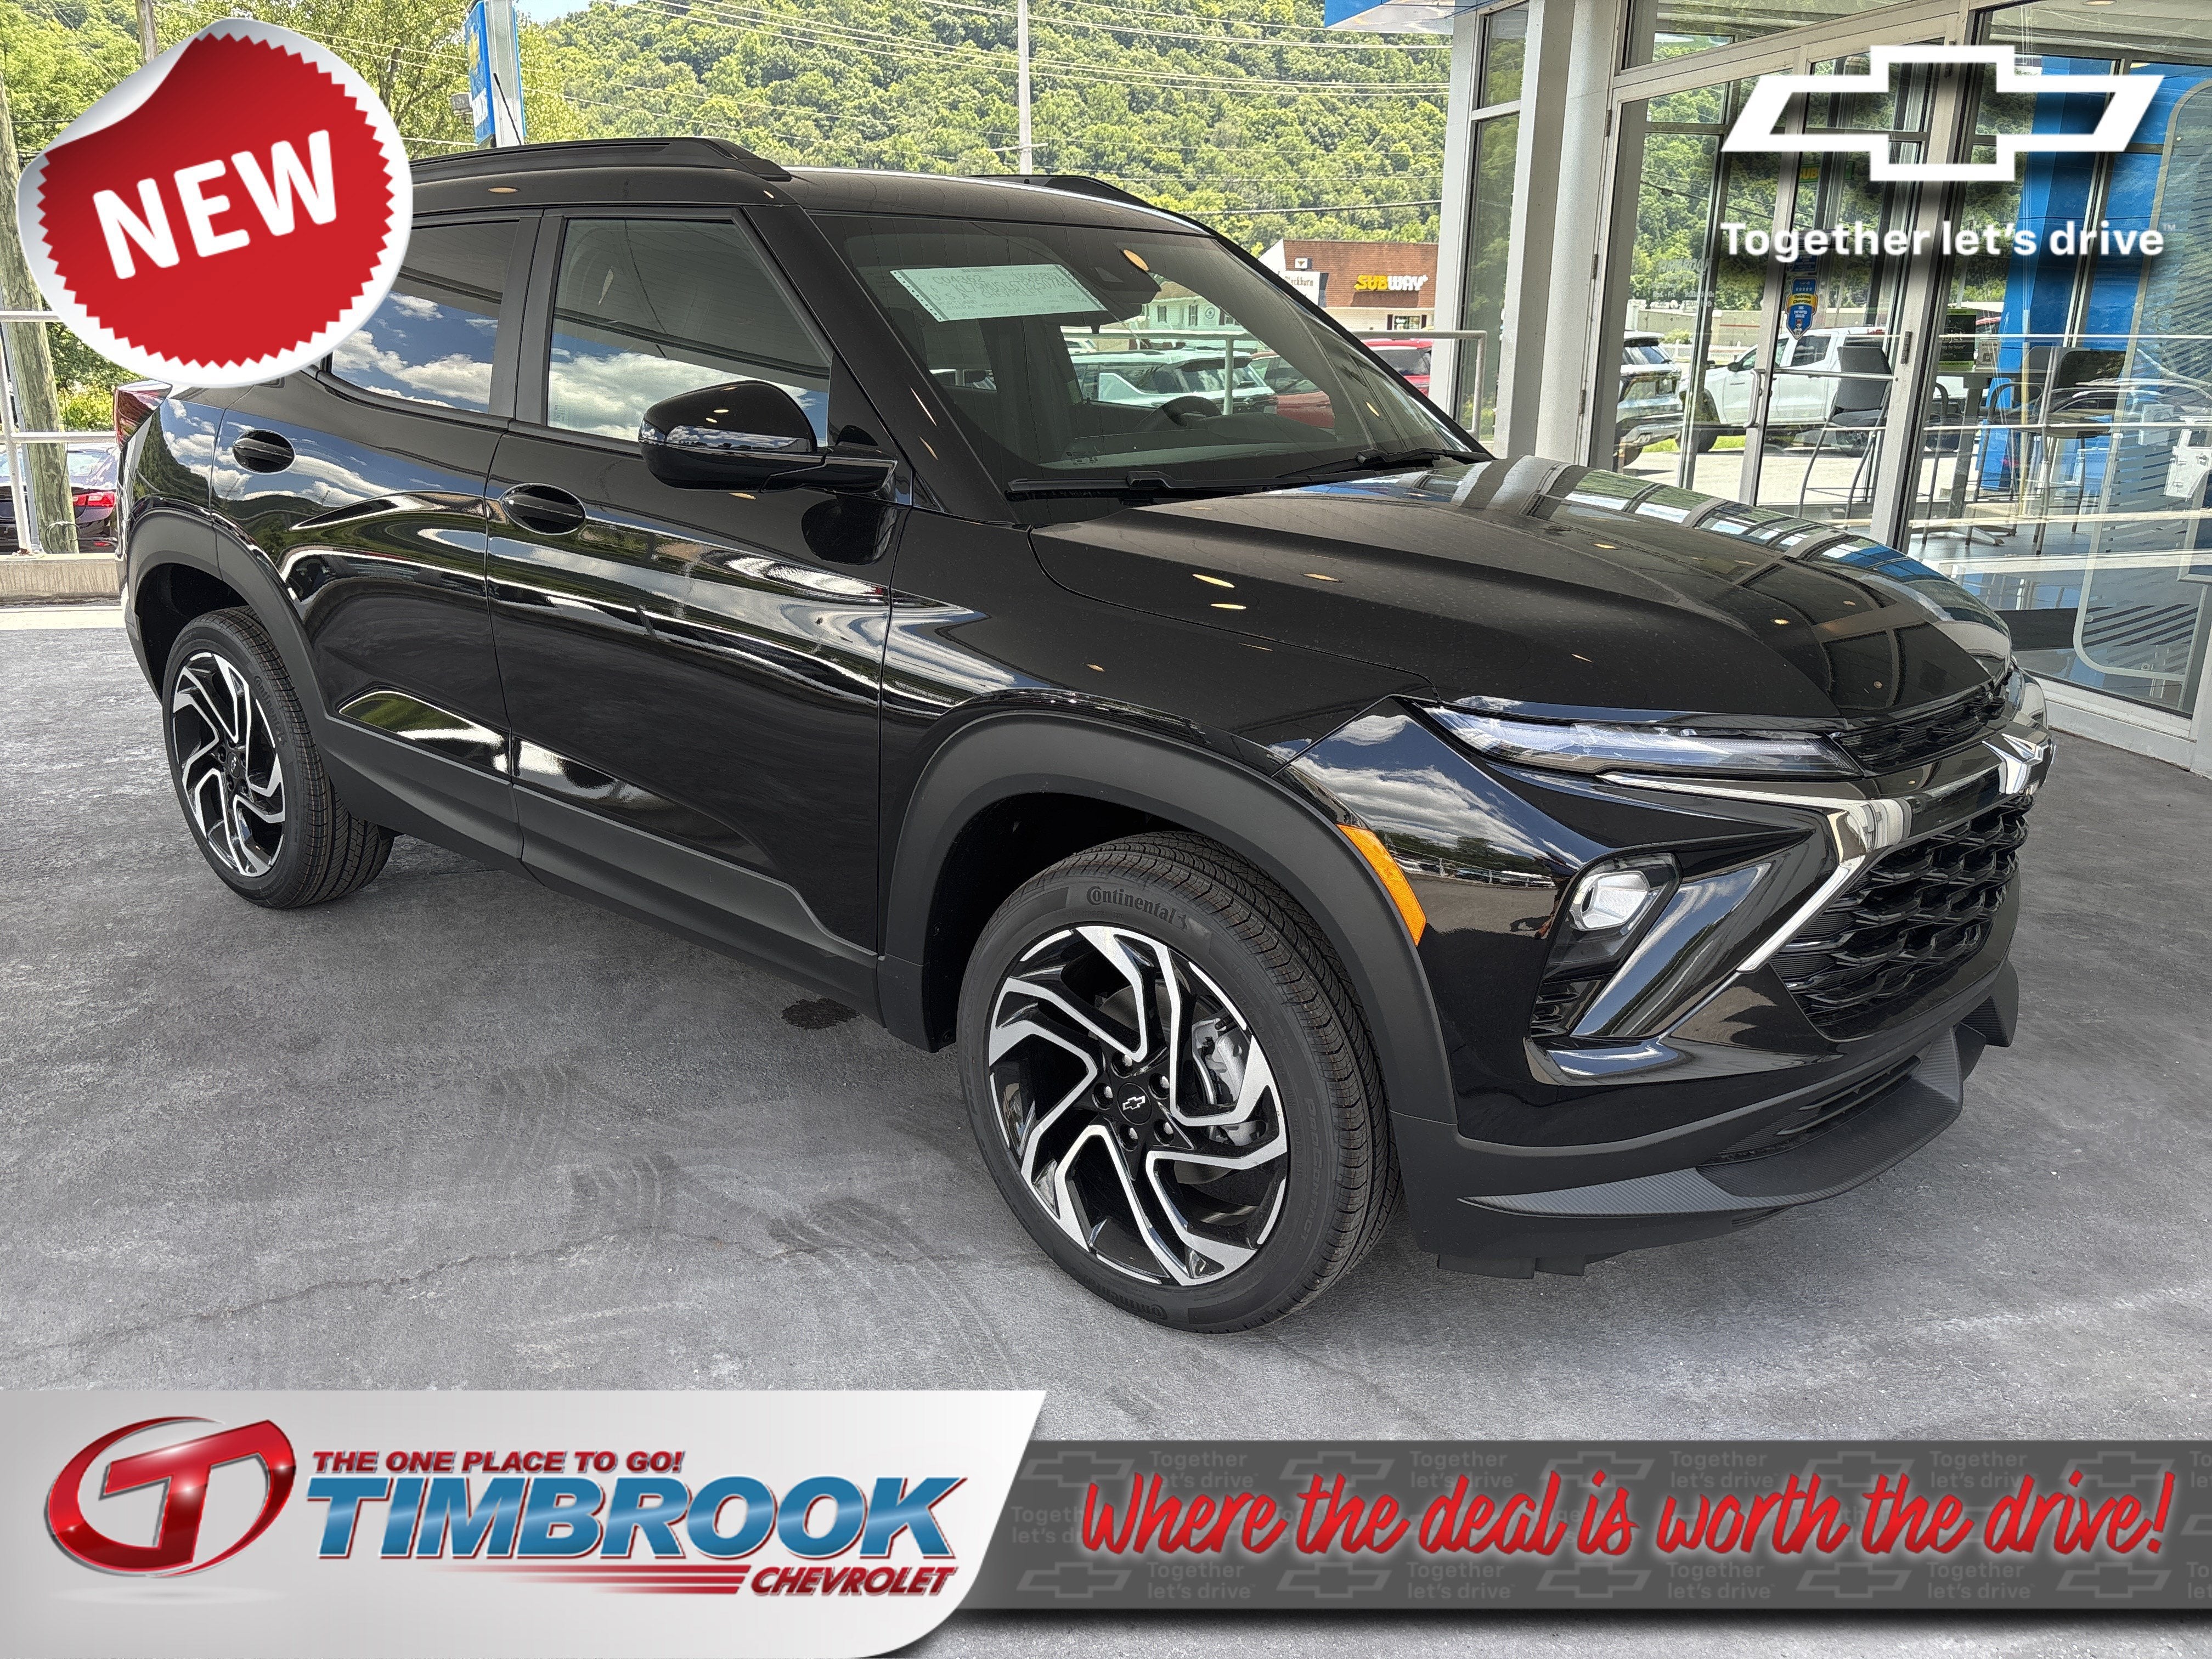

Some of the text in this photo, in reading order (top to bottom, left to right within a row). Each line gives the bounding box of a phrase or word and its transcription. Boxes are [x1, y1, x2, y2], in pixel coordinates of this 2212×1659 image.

[981, 288, 1045, 298] CHEVROLET
[1353, 274, 1429, 291] SUBWAY
[1086, 885, 1177, 925] Continental
[1081, 1271, 1168, 1321] Continental
